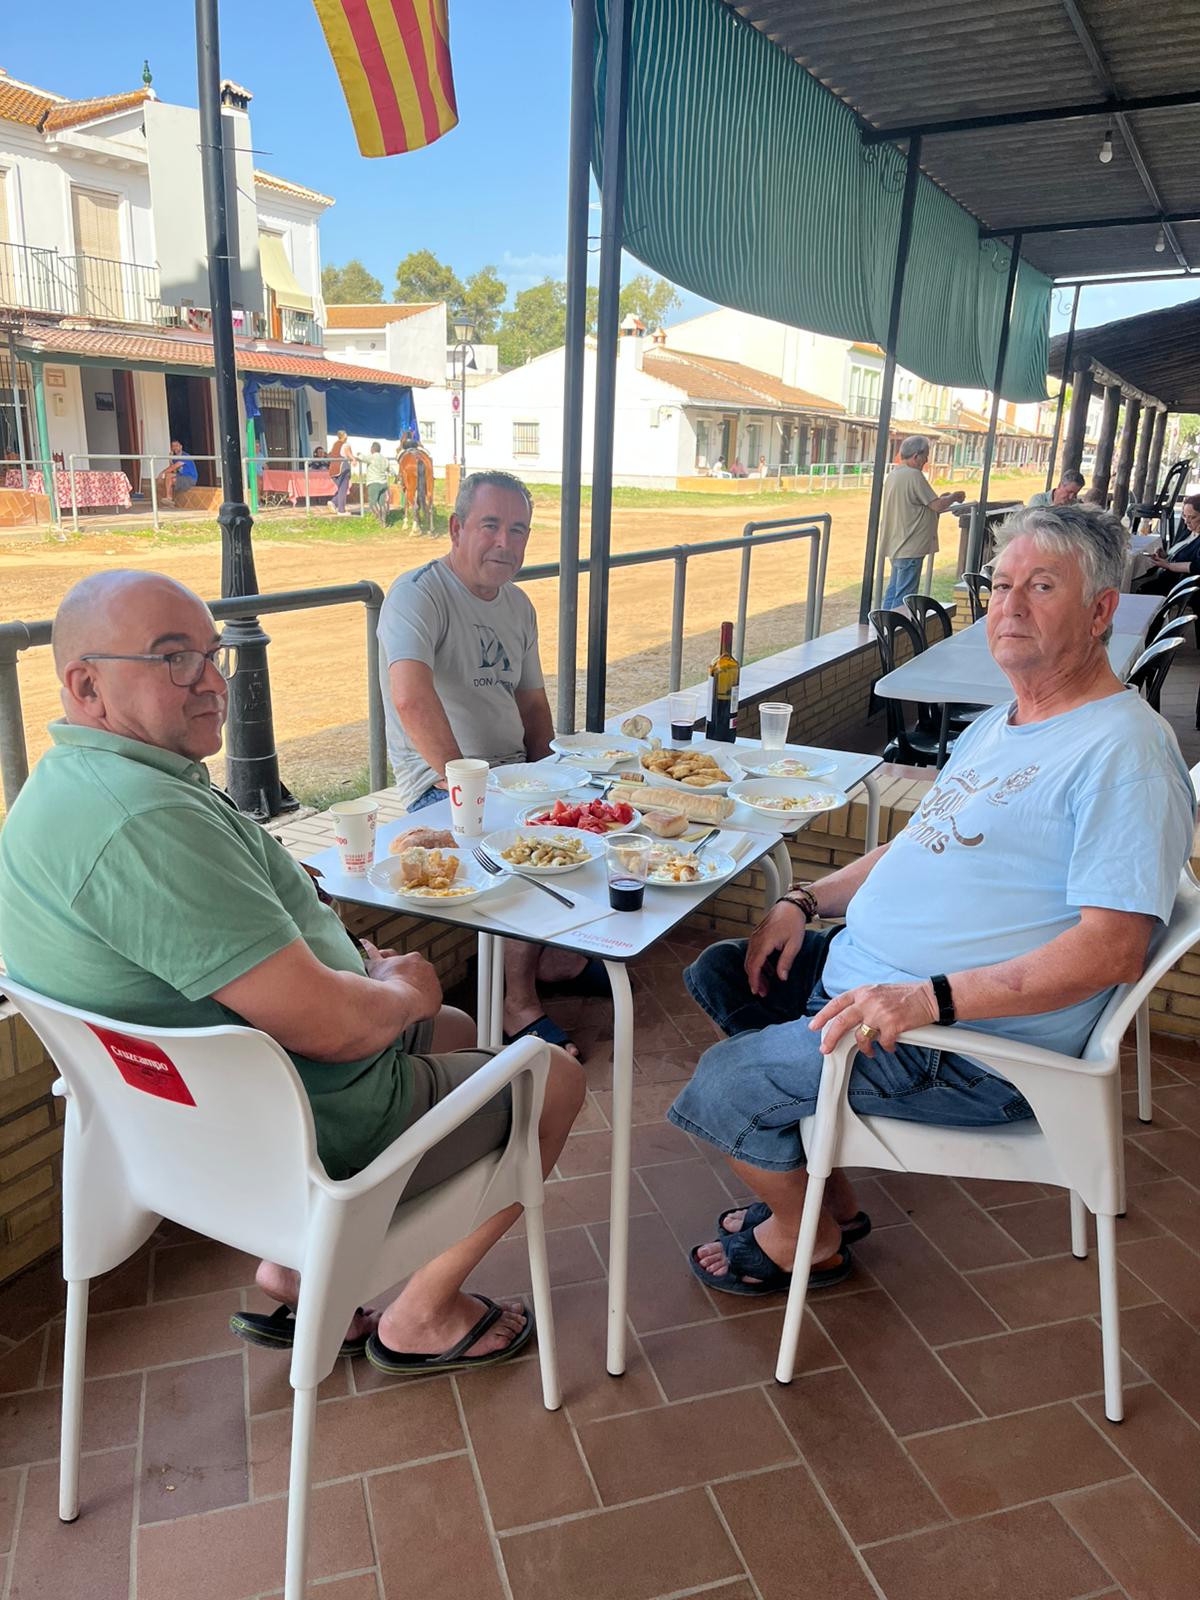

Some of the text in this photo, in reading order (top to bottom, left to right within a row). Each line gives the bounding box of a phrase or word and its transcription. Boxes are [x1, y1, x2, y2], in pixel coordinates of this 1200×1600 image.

[473, 678, 493, 688] DON
[451, 785, 463, 807] C
[110, 1044, 169, 1071] Cruzcampo
